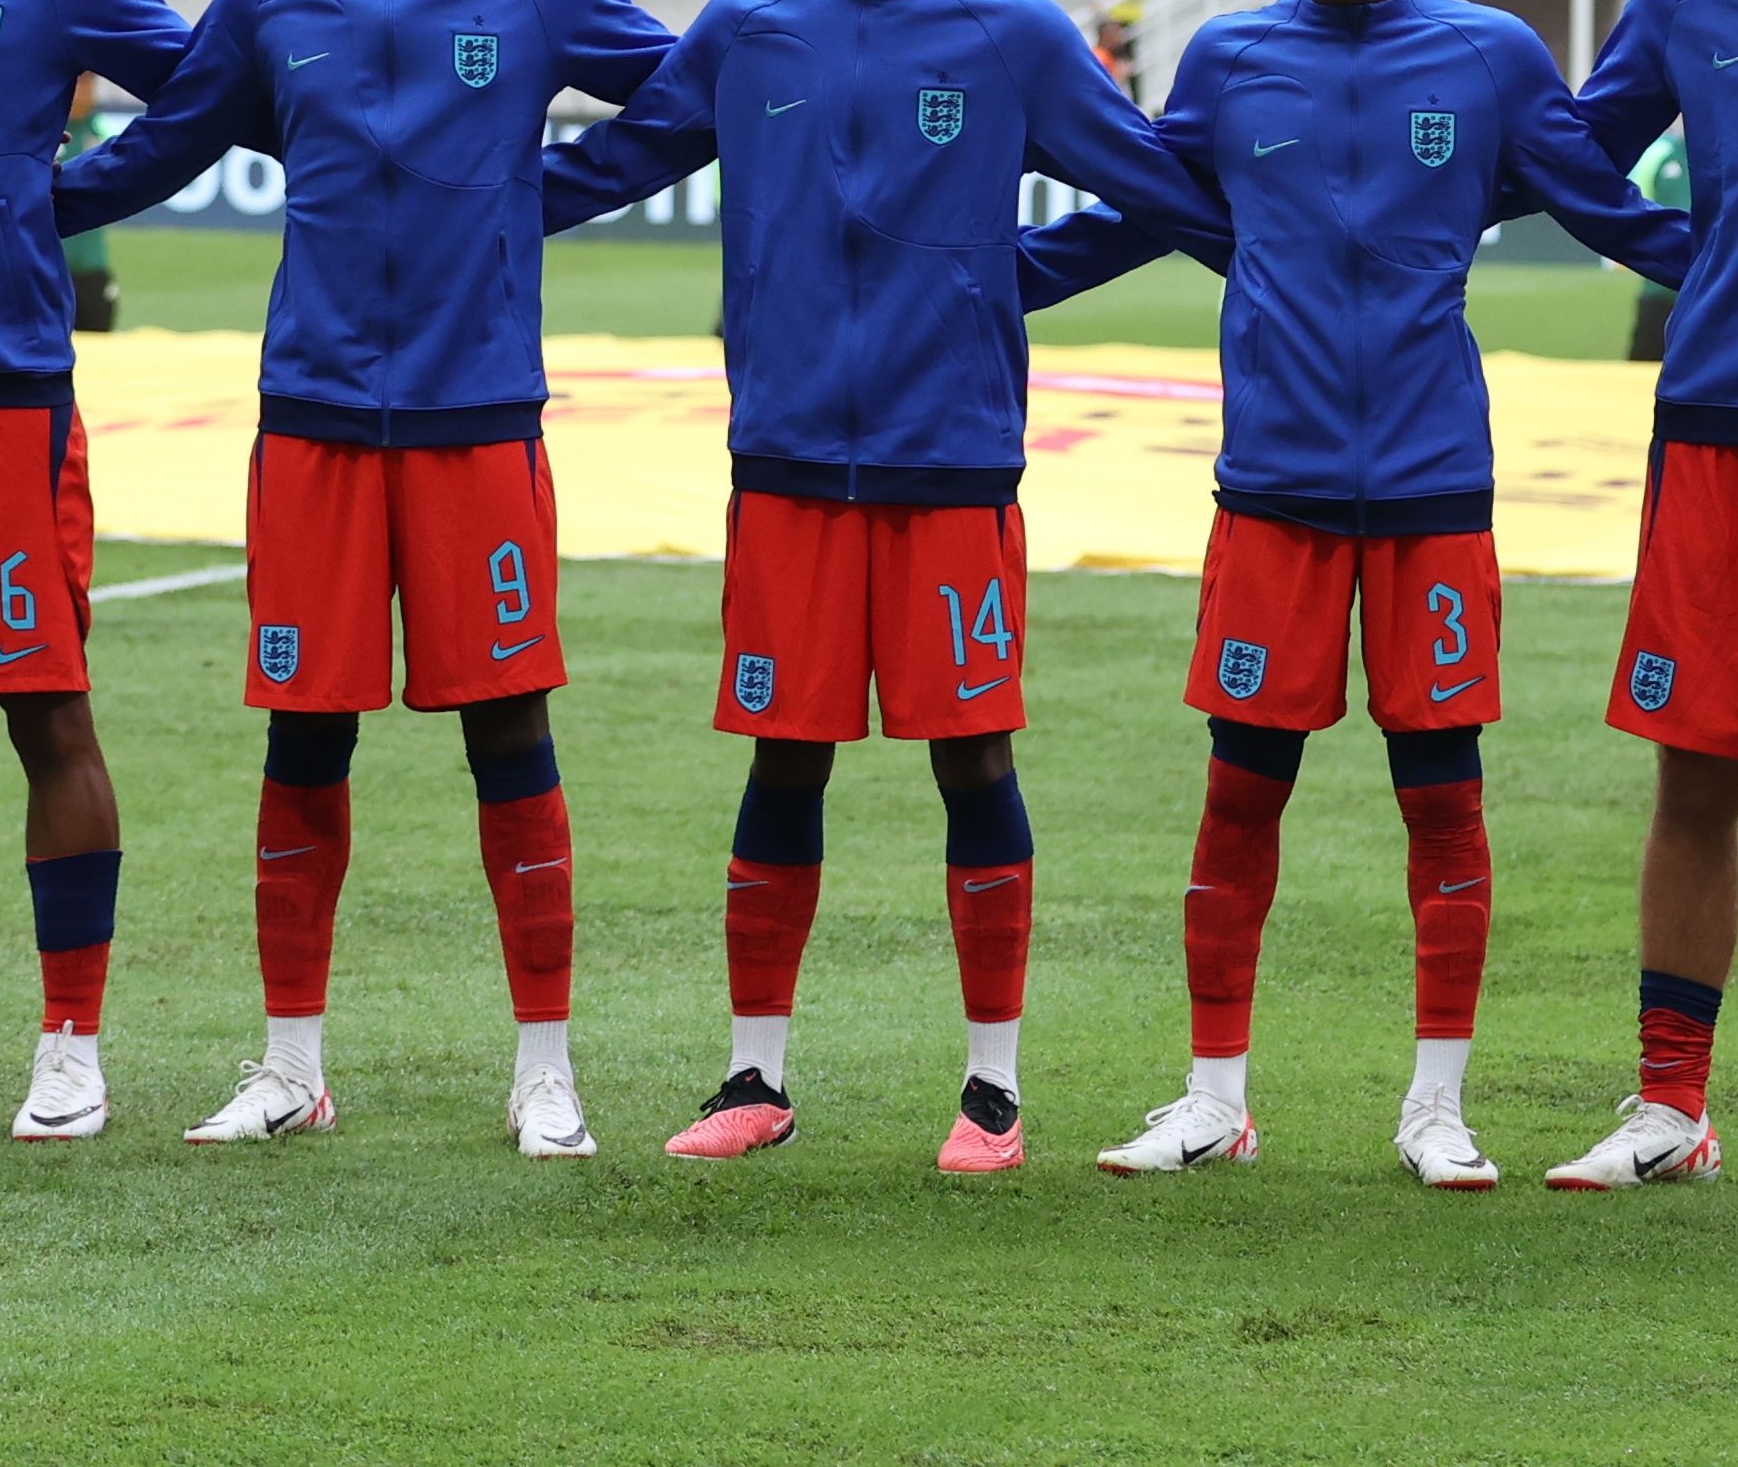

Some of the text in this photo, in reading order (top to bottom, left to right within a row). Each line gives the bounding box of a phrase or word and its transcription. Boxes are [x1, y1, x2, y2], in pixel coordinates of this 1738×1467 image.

[0, 549, 36, 631] 6
[488, 538, 532, 626] 9
[938, 576, 1014, 668] 14
[1427, 581, 1468, 667] 3
